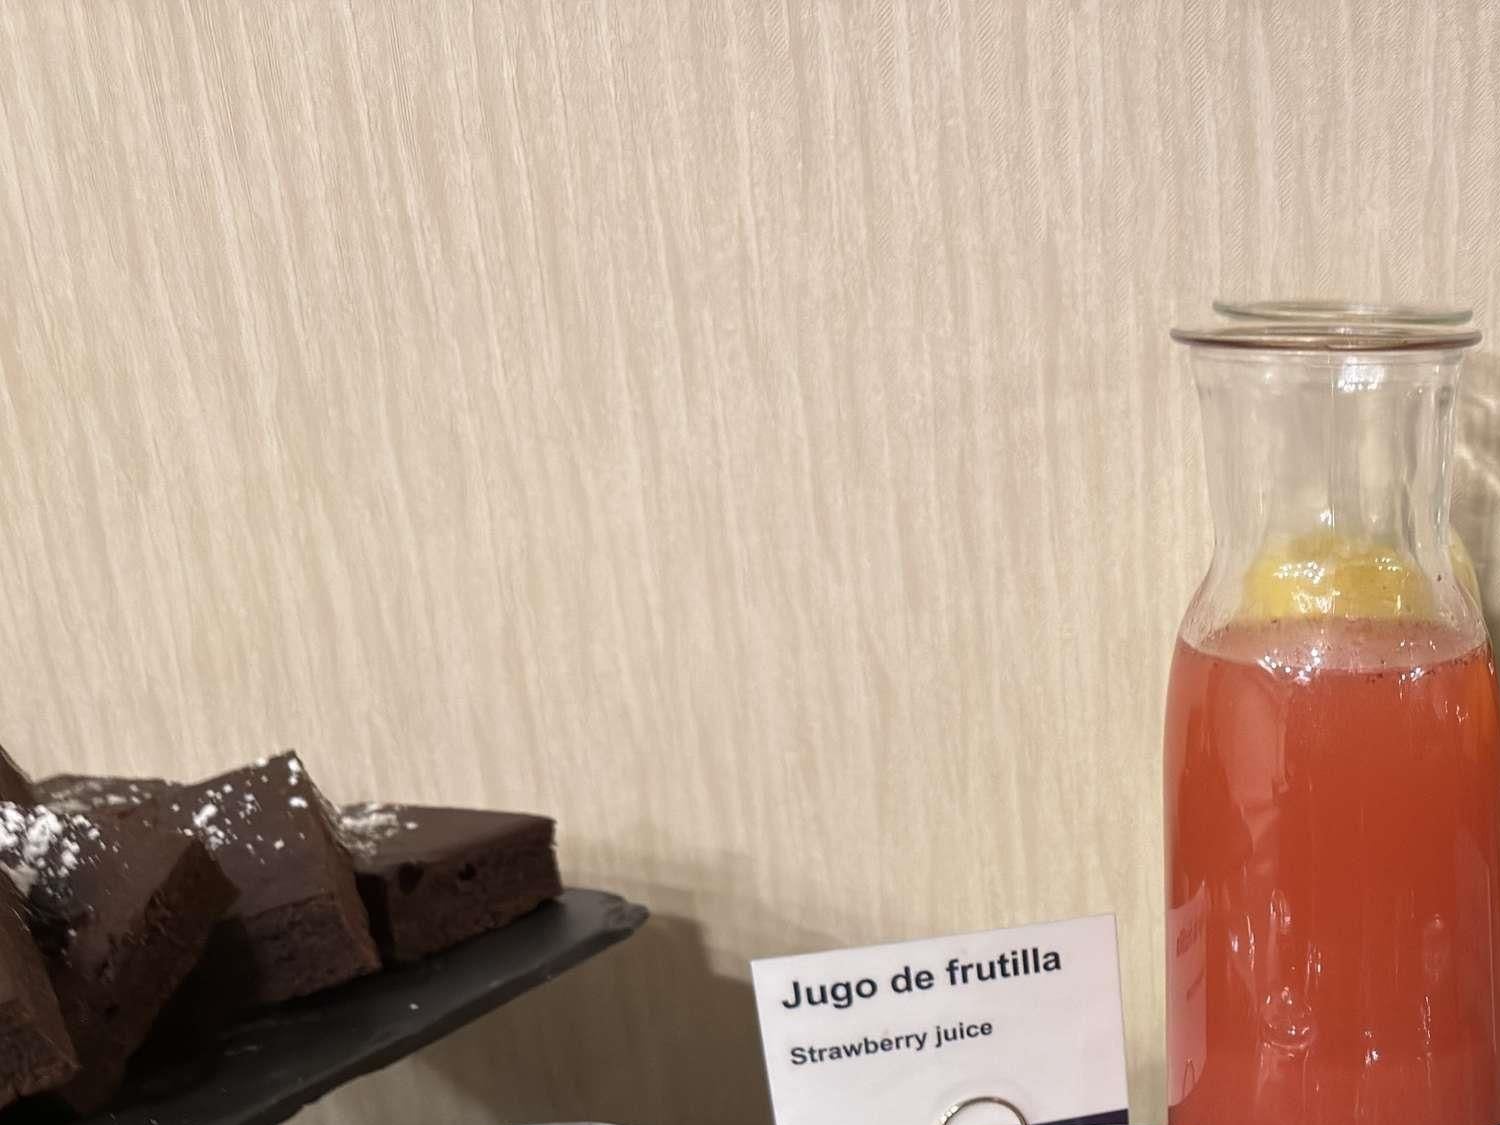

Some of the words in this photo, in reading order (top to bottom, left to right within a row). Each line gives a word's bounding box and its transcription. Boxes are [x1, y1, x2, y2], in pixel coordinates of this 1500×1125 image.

[782, 977, 878, 1009] Jugo
[890, 966, 935, 994] de
[946, 947, 1062, 986] frutilla
[790, 1031, 928, 1065] Strawberry
[935, 1021, 993, 1048] juice
